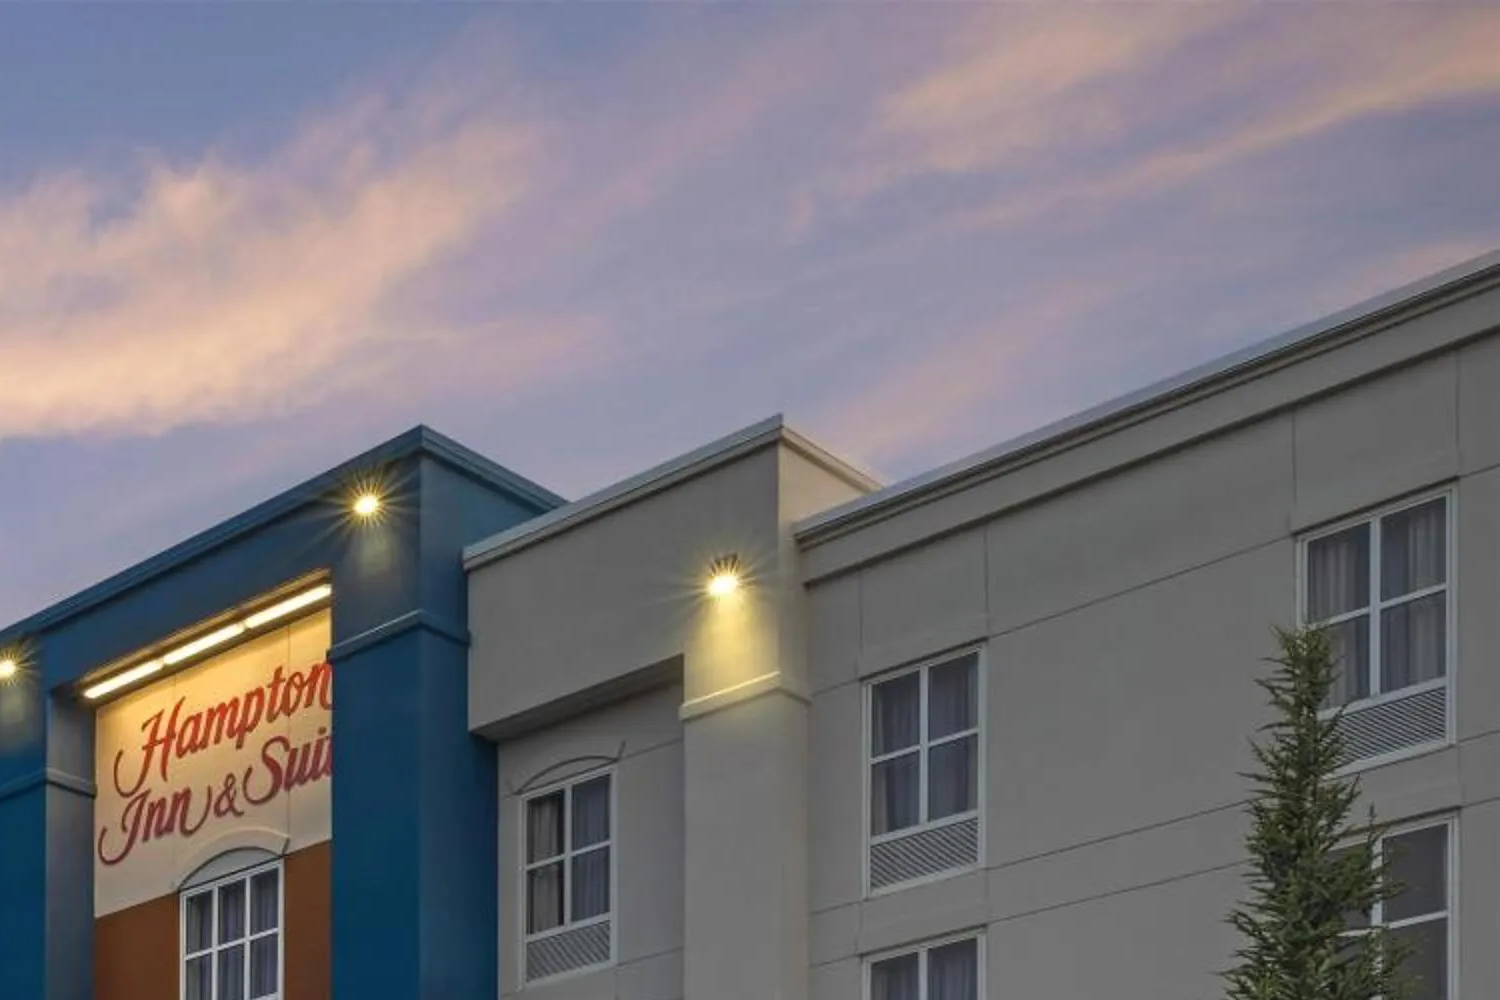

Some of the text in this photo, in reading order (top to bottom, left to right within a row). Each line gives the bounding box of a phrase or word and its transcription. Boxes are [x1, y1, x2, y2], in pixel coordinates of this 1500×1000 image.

[113, 661, 333, 798] Hampton
[98, 785, 211, 866] Inn
[213, 772, 244, 817] &
